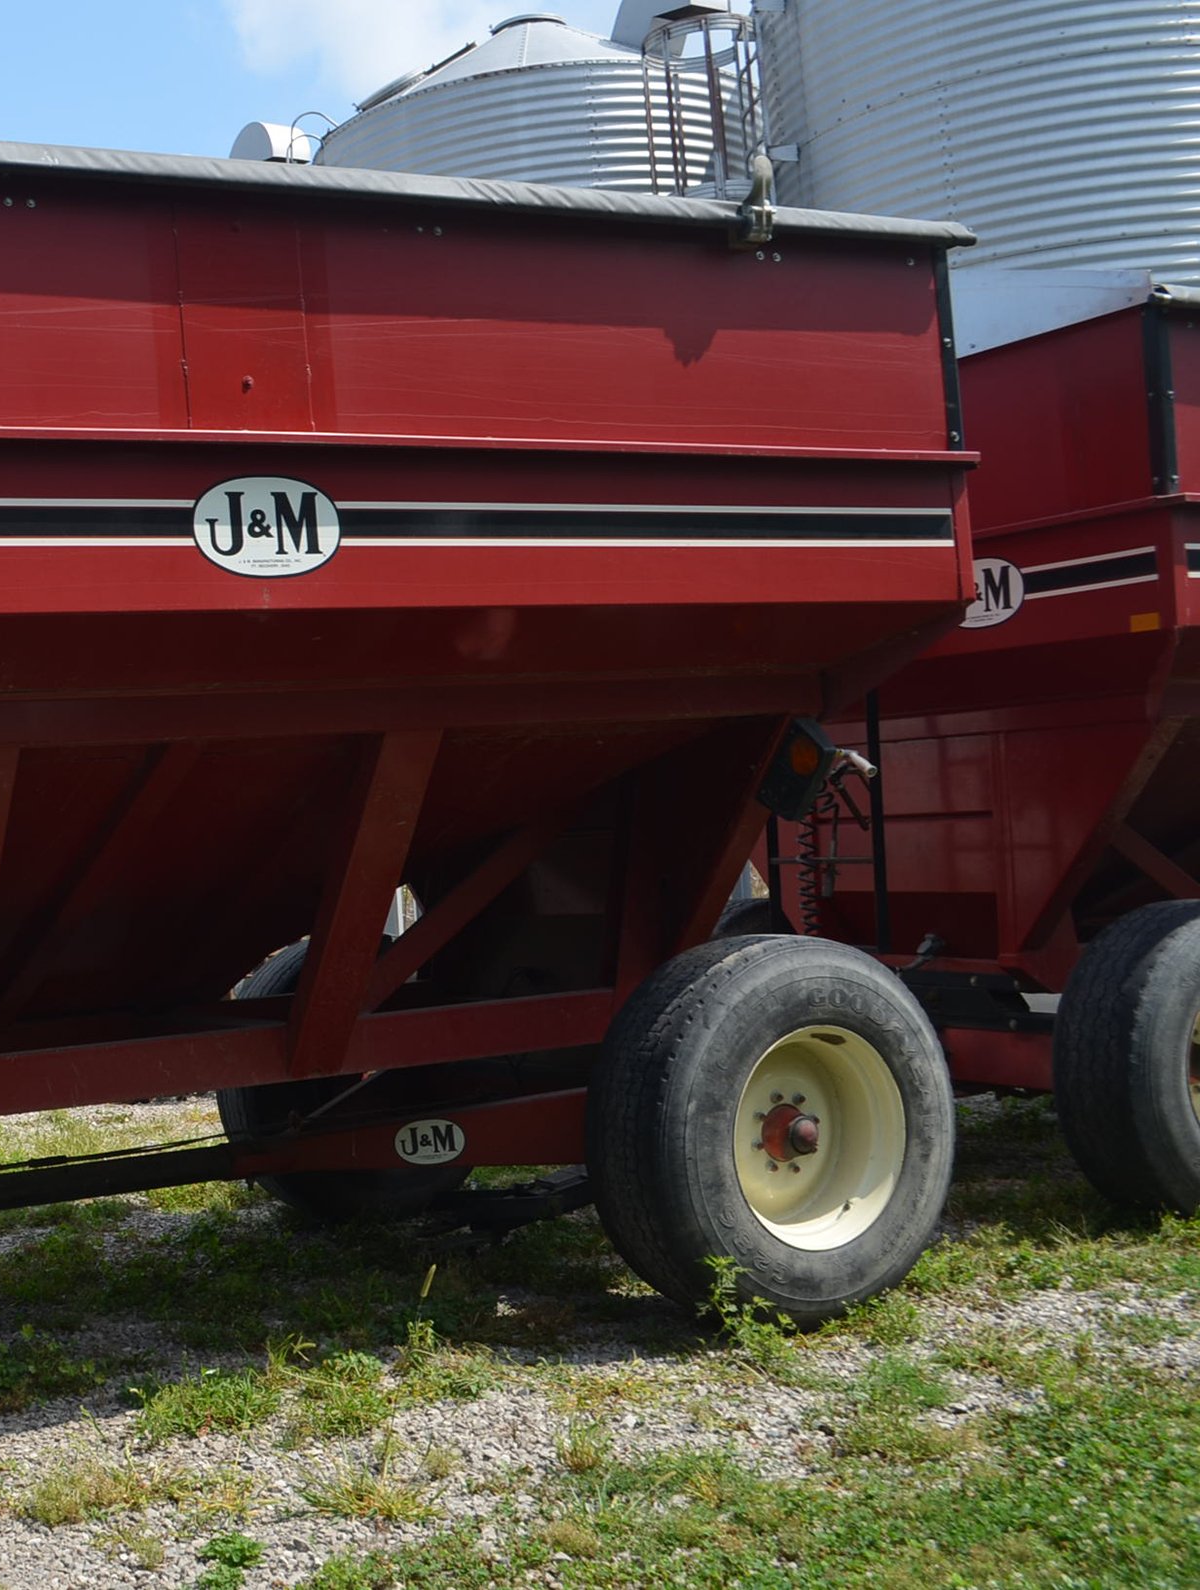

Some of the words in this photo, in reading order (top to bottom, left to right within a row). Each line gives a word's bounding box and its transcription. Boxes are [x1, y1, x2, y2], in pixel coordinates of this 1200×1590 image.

[205, 491, 322, 556] J&M
[974, 566, 1012, 611] &M
[401, 1125, 457, 1155] J&M
